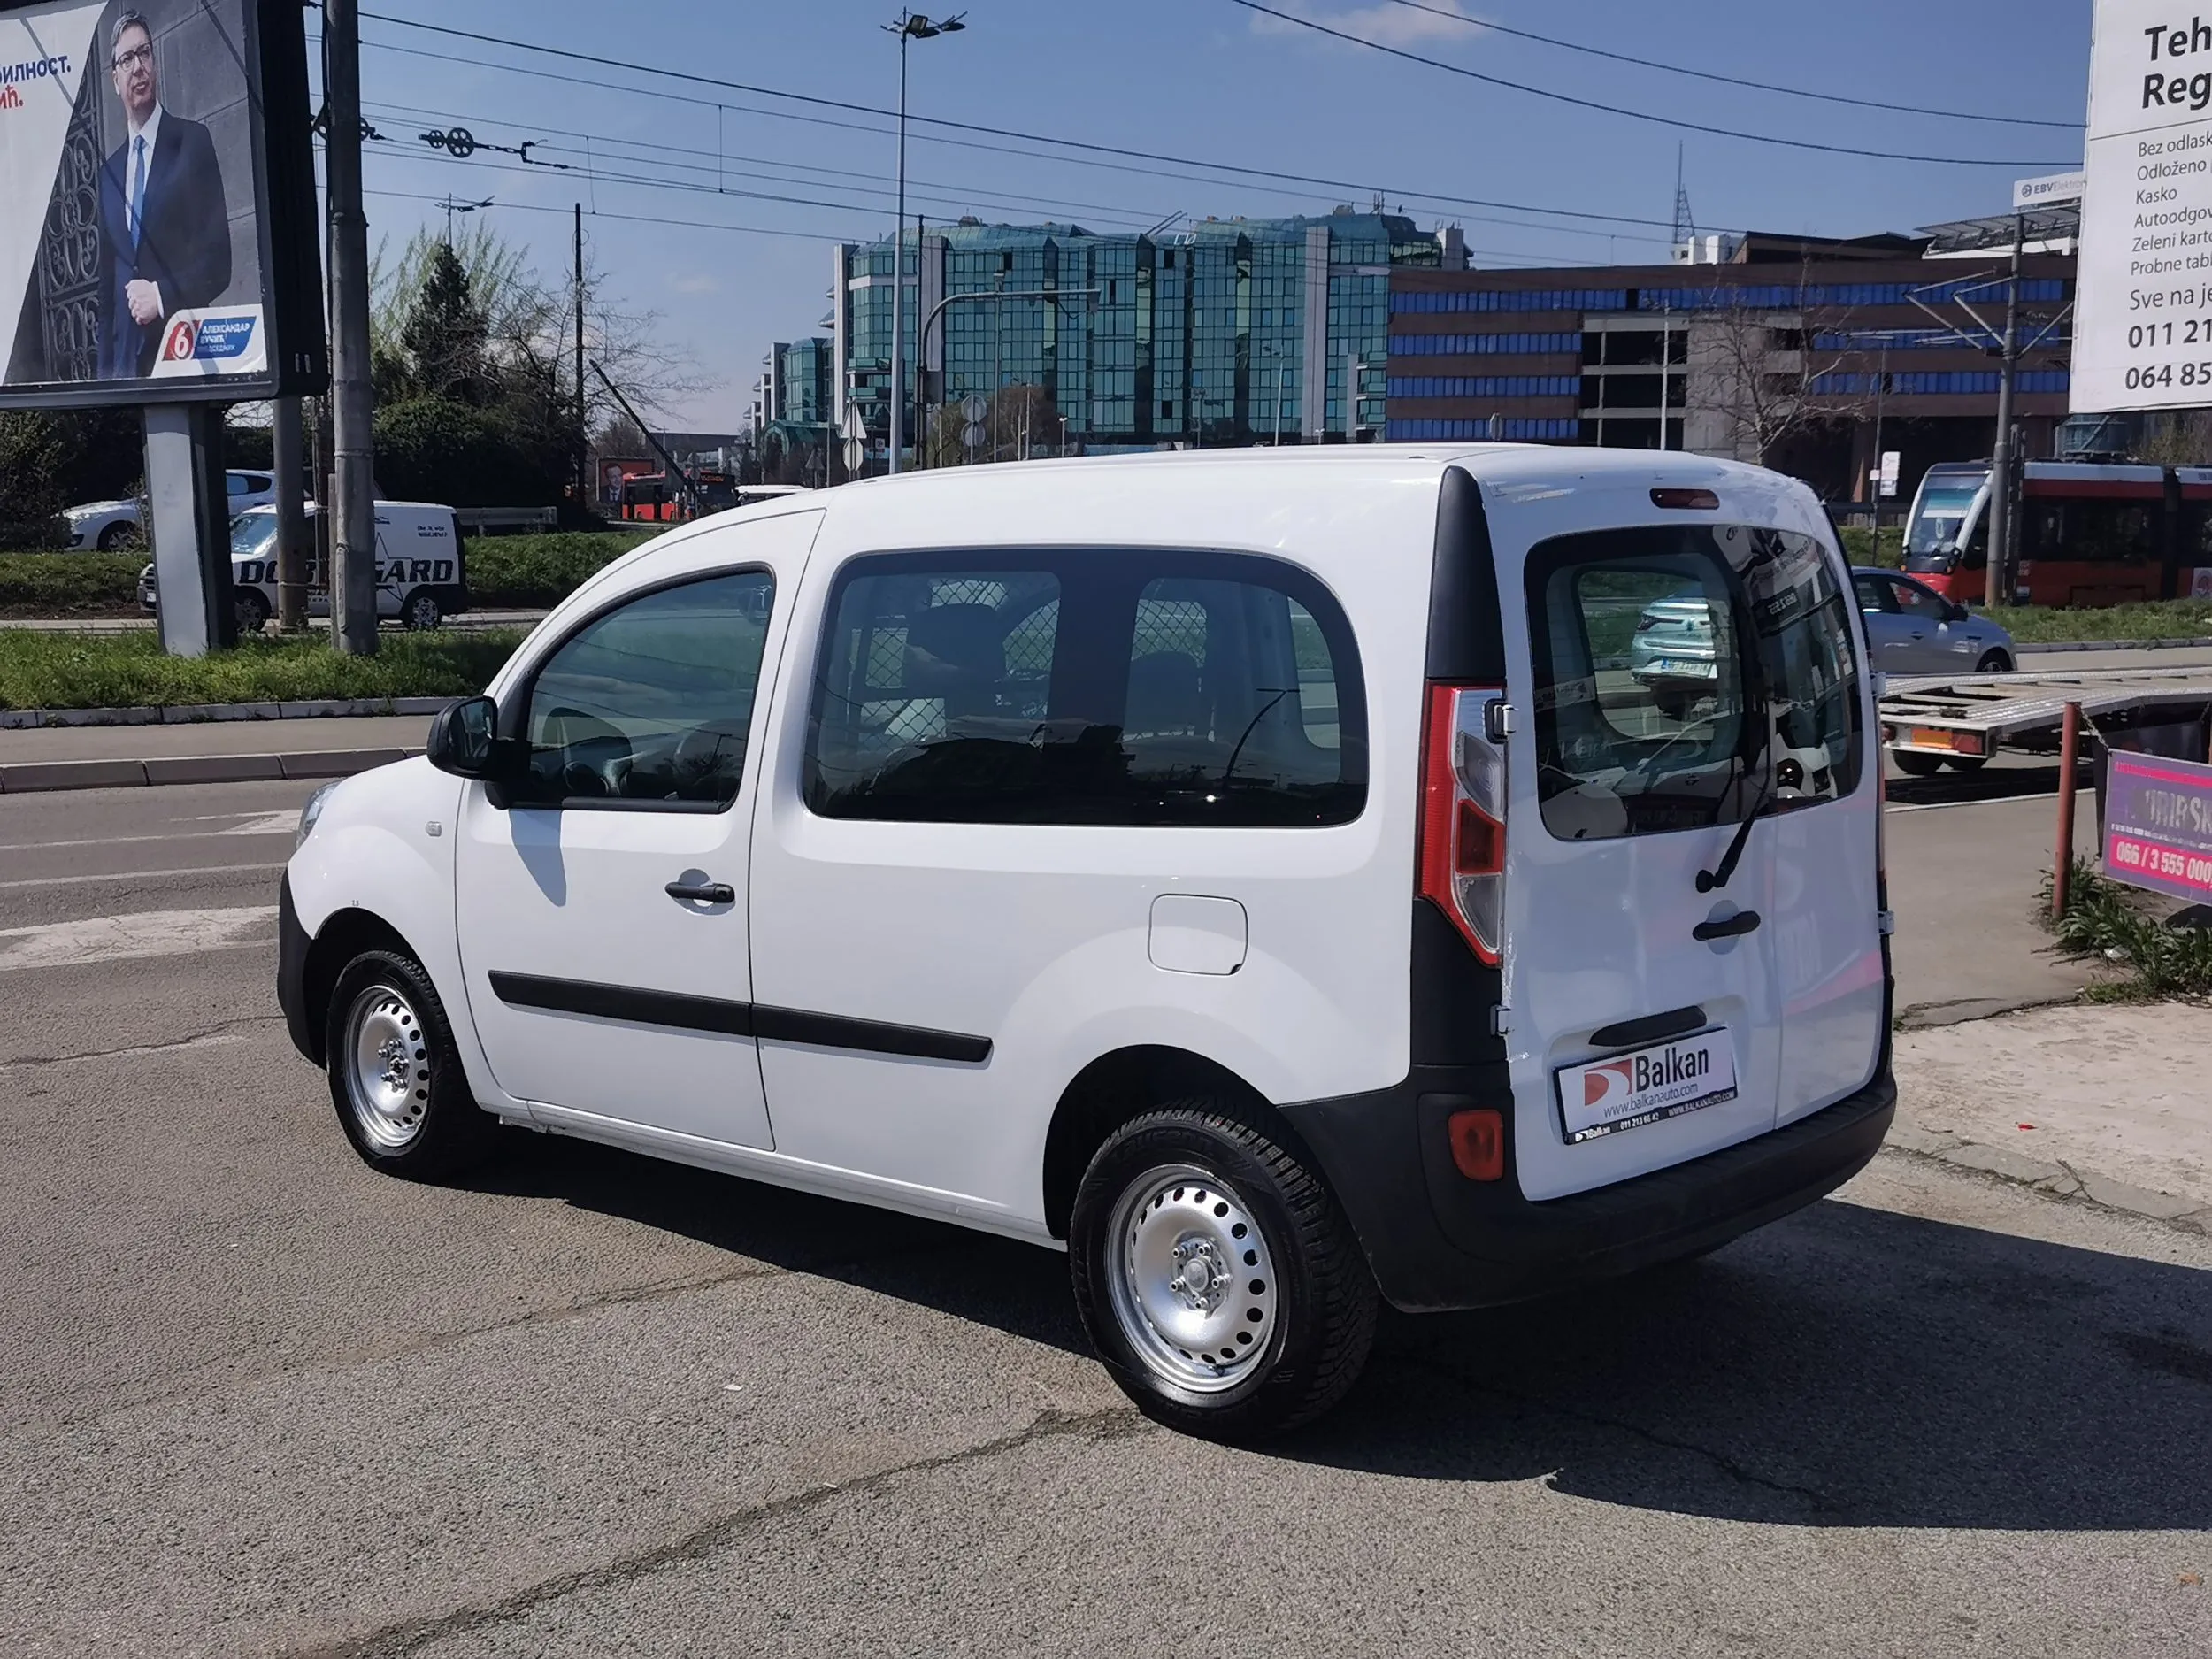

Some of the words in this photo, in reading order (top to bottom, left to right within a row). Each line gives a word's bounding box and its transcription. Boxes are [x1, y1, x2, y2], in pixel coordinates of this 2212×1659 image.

[2145, 16, 2211, 61] Teh
[0, 55, 72, 84] илност.
[2142, 73, 2212, 111] Reg
[2139, 142, 2163, 157] Bez
[2138, 160, 2207, 180] Odloženo
[2136, 186, 2177, 204] Kasko
[2131, 233, 2176, 252] Zeleni
[2131, 257, 2182, 276] Probne
[2130, 289, 2164, 311] Sve
[2170, 289, 2194, 306] na
[174, 324, 189, 357] 6
[2128, 322, 2172, 348] 011
[2183, 319, 2212, 343] 21
[2125, 365, 2172, 389] 064
[2180, 362, 2212, 386] 85
[2116, 841, 2139, 864] 066
[2150, 849, 2159, 869] 3
[2161, 851, 2184, 876] 555
[1635, 1047, 1709, 1093] Balkan
[1603, 1082, 1699, 1118] www.balkanauto.com
